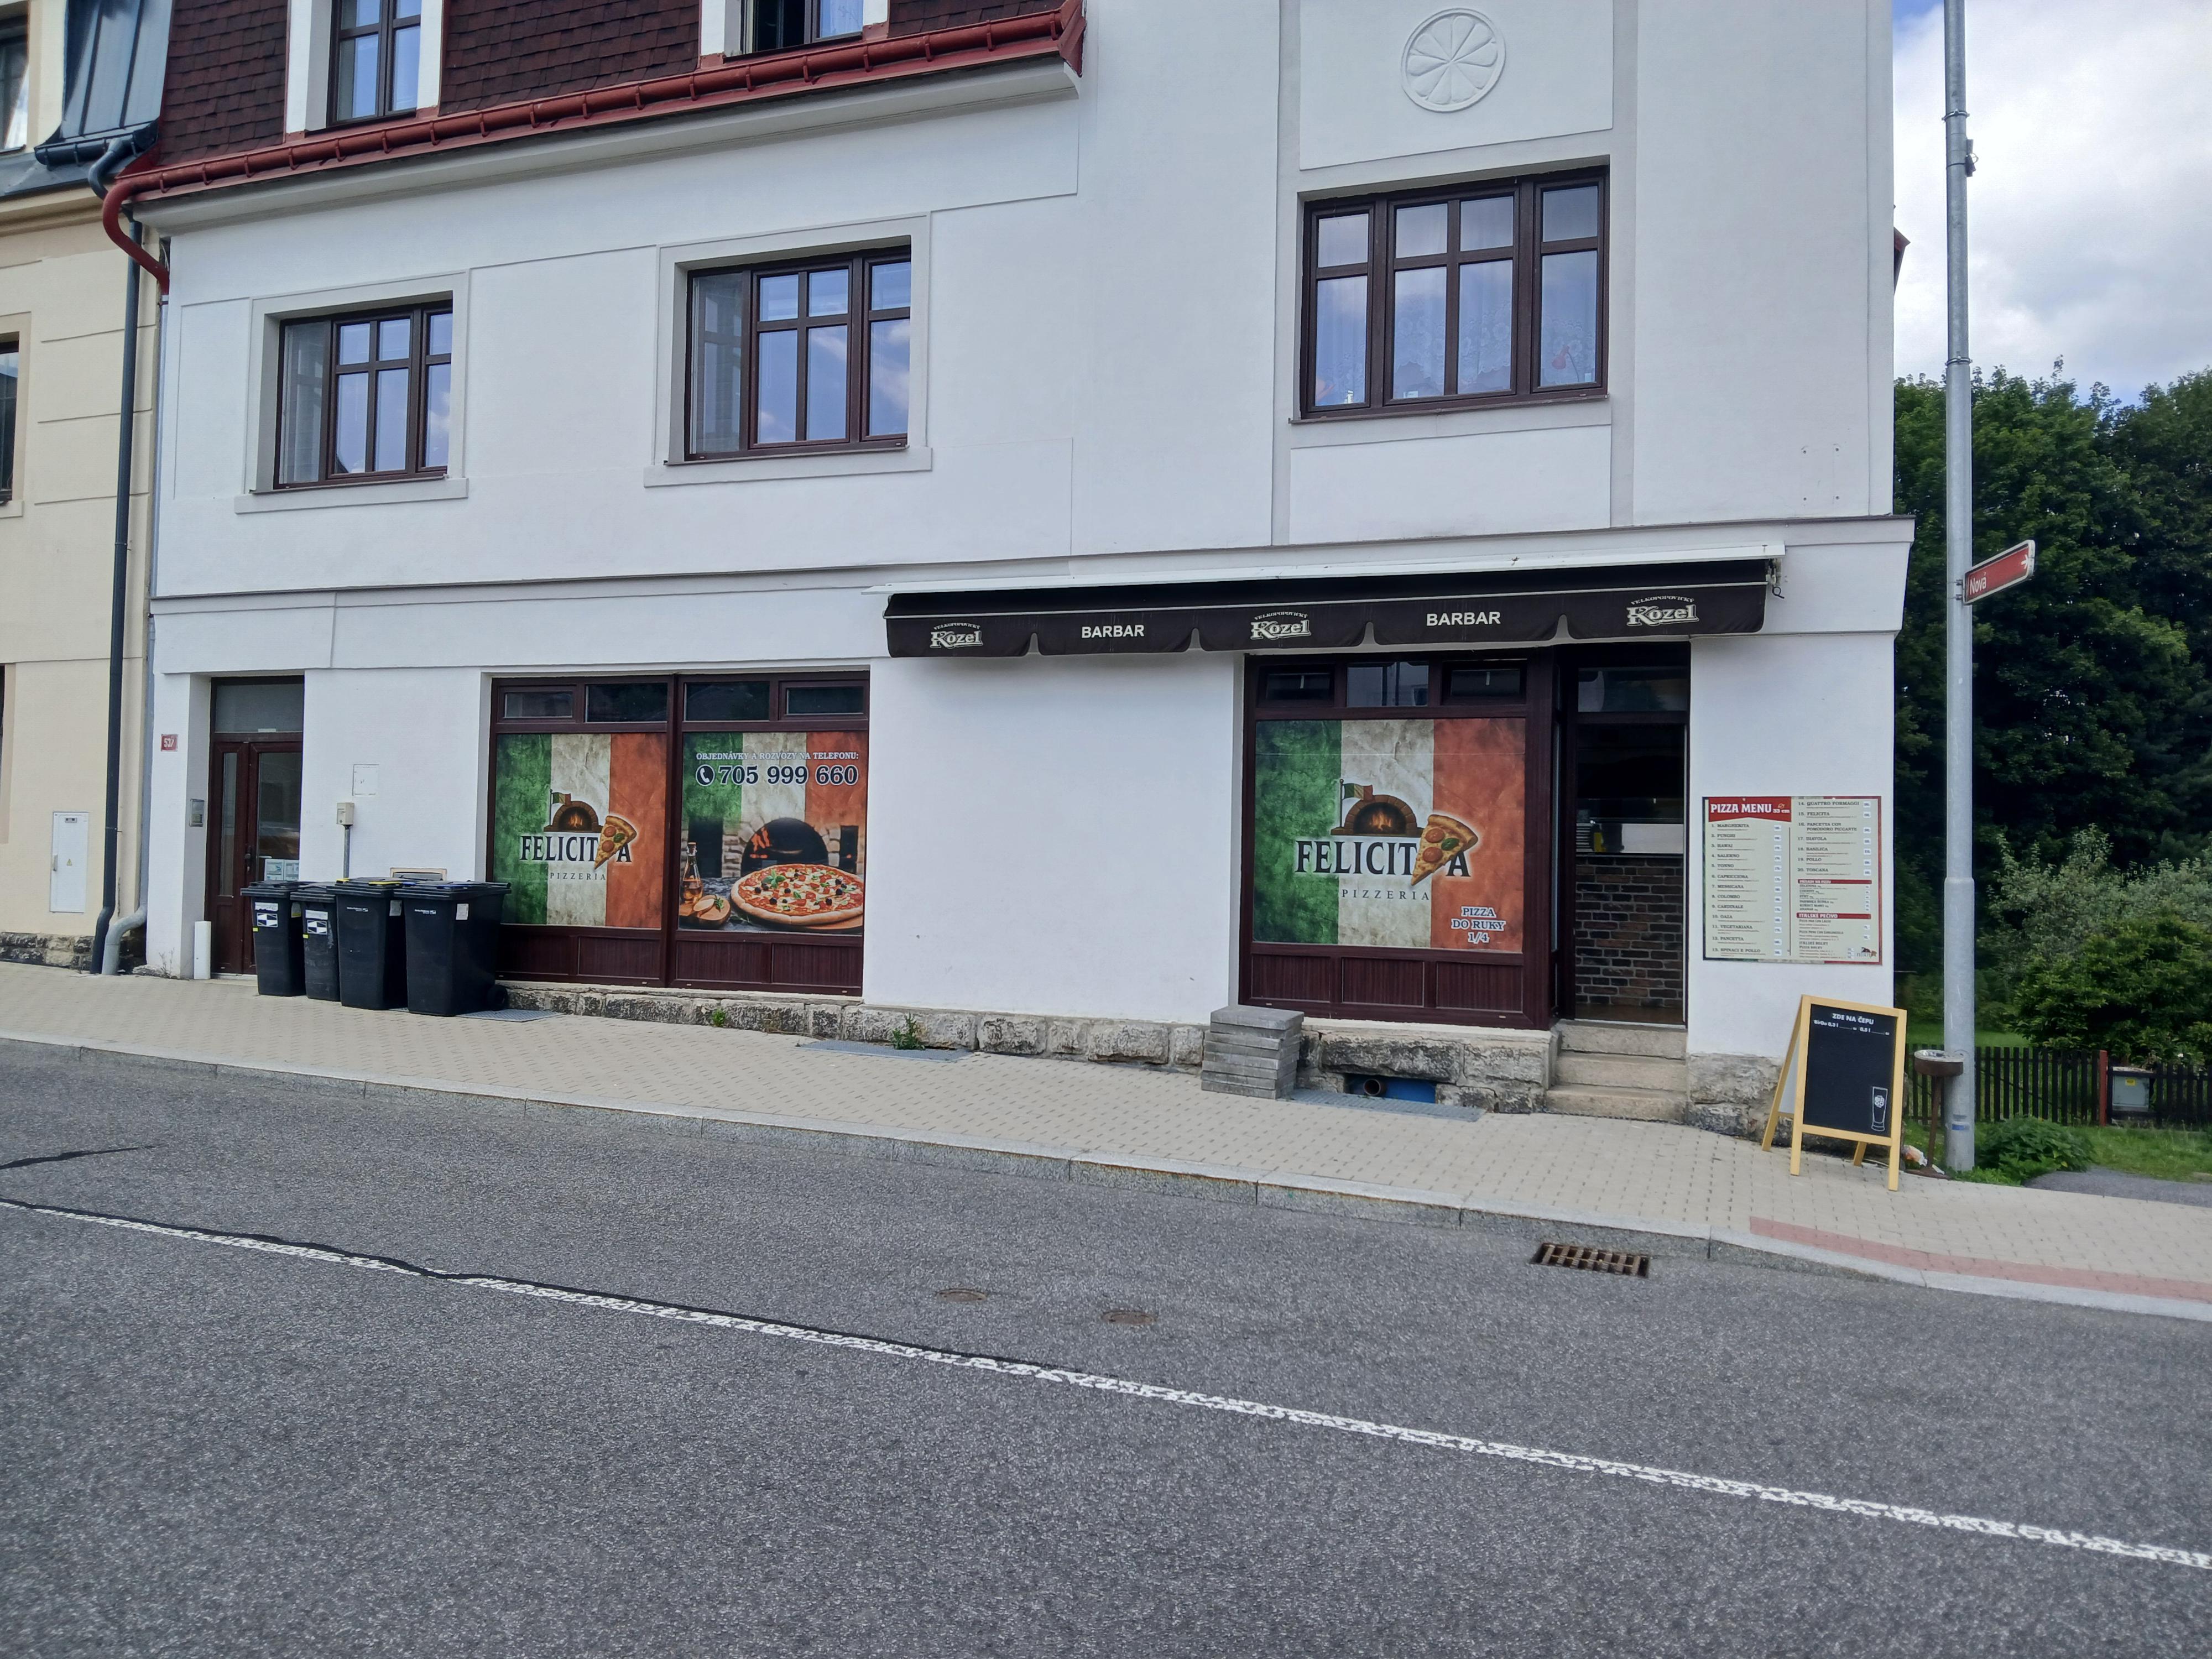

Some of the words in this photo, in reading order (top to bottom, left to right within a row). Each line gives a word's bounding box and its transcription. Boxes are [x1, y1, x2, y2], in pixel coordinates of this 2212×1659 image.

[1969, 572, 1986, 595] Nová
[1426, 612, 1501, 626] BARBAR
[1626, 604, 1699, 626] Kozel
[1082, 624, 1145, 638] BARBAR
[1250, 619, 1311, 640] Kozel
[930, 630, 983, 649] Kozel
[164, 738, 174, 747] 537
[696, 751, 748, 760] OBJEDNÁVKY
[718, 765, 759, 785] 705
[766, 765, 808, 785] 999
[815, 764, 859, 785] 660
[1710, 804, 1738, 813] PIZZA
[1741, 804, 1772, 813] MENU
[550, 872, 606, 880] PIZZERIA
[1342, 889, 1429, 900] PIZZERIA
[1462, 907, 1496, 917] PIZZA
[1452, 919, 1470, 929] DO
[1472, 920, 1505, 931] RUKY
[1468, 932, 1489, 943] 1/4
[1858, 1016, 1874, 1025] ČEPU
